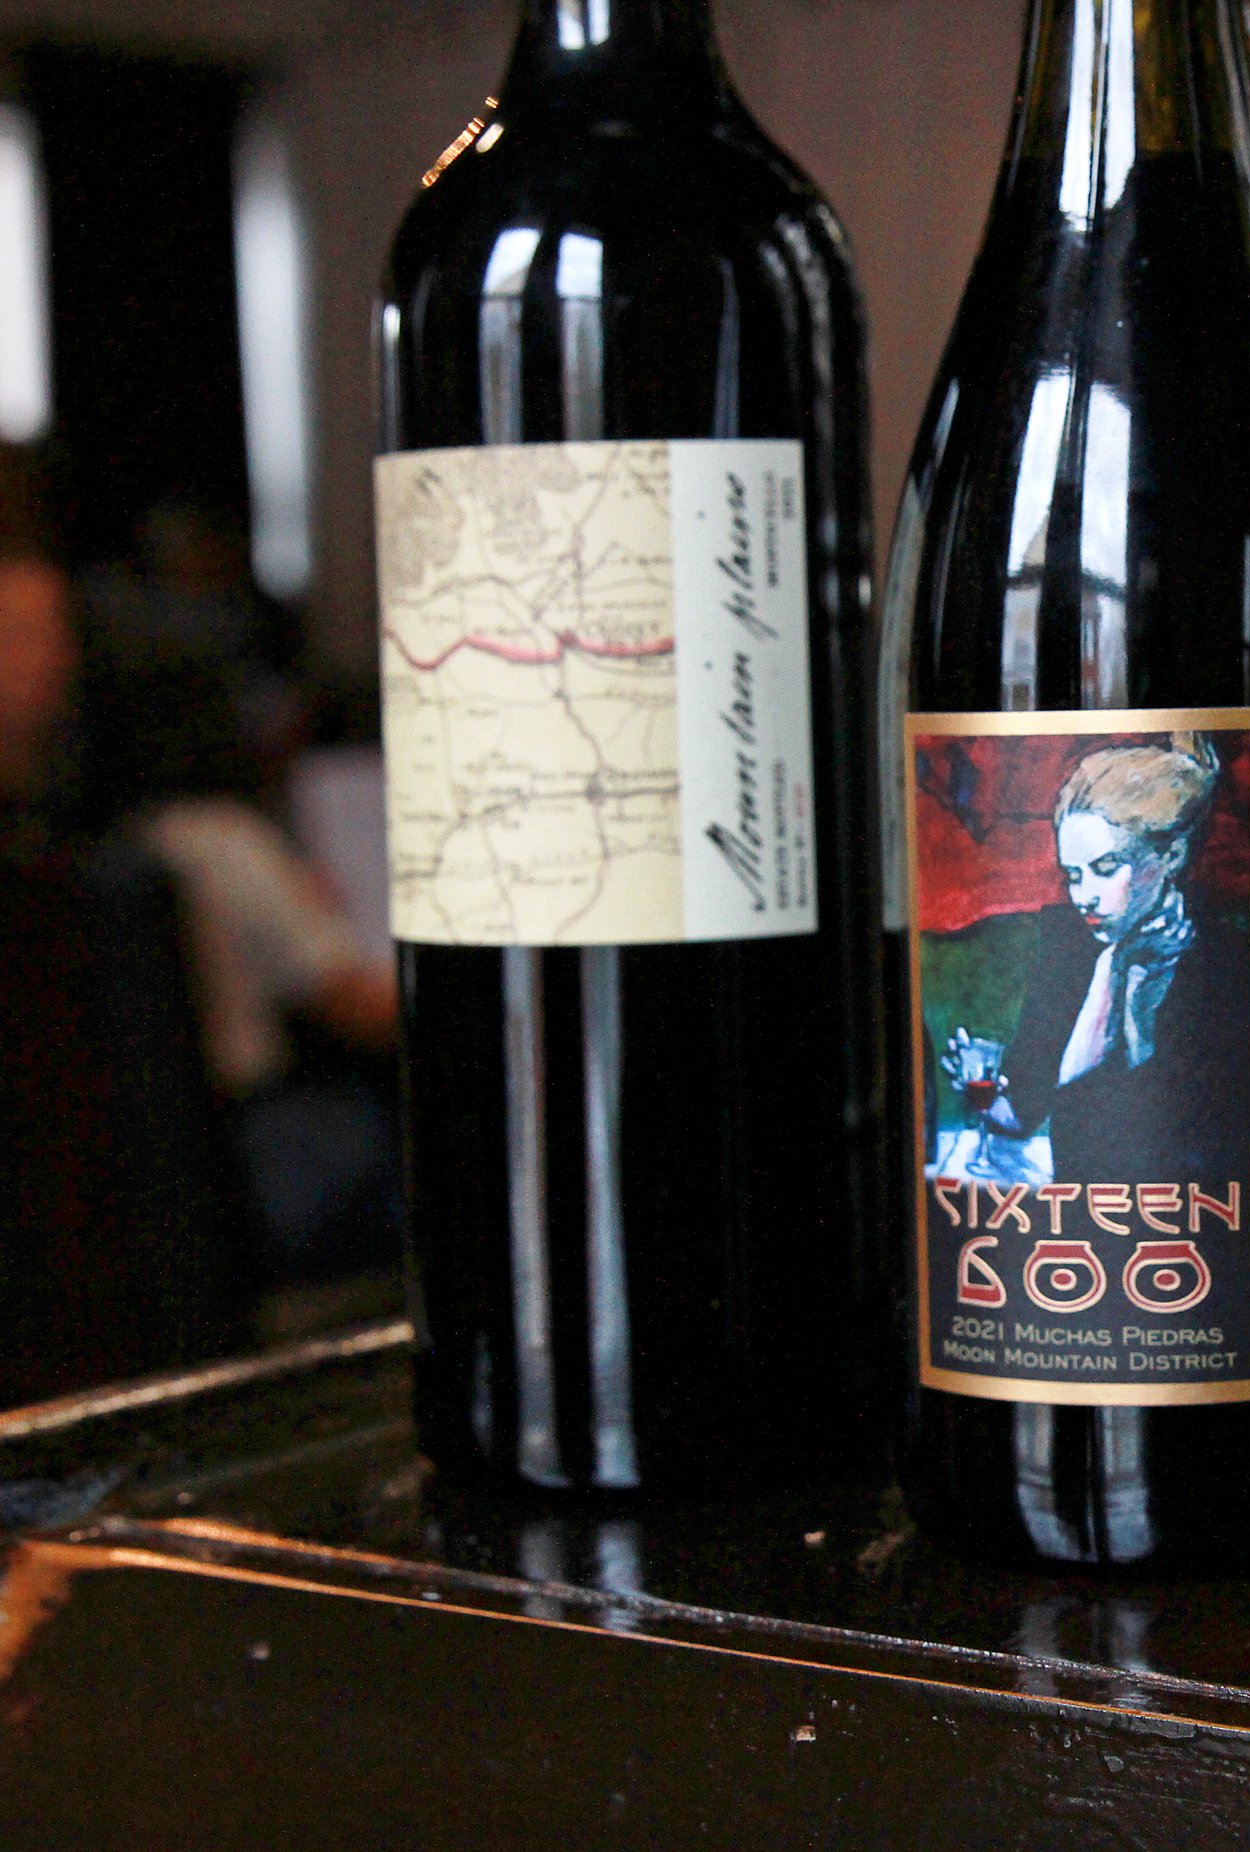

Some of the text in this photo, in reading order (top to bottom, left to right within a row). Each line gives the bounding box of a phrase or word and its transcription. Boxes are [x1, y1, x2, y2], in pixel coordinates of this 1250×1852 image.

[934, 1177, 1241, 1236] SIXTEEN
[957, 1235, 1212, 1314] 600
[951, 1315, 1224, 1346] 2021 MUCHAS PIEDRAS
[943, 1339, 1239, 1371] MOON MOUNTAIN DISTRICT
